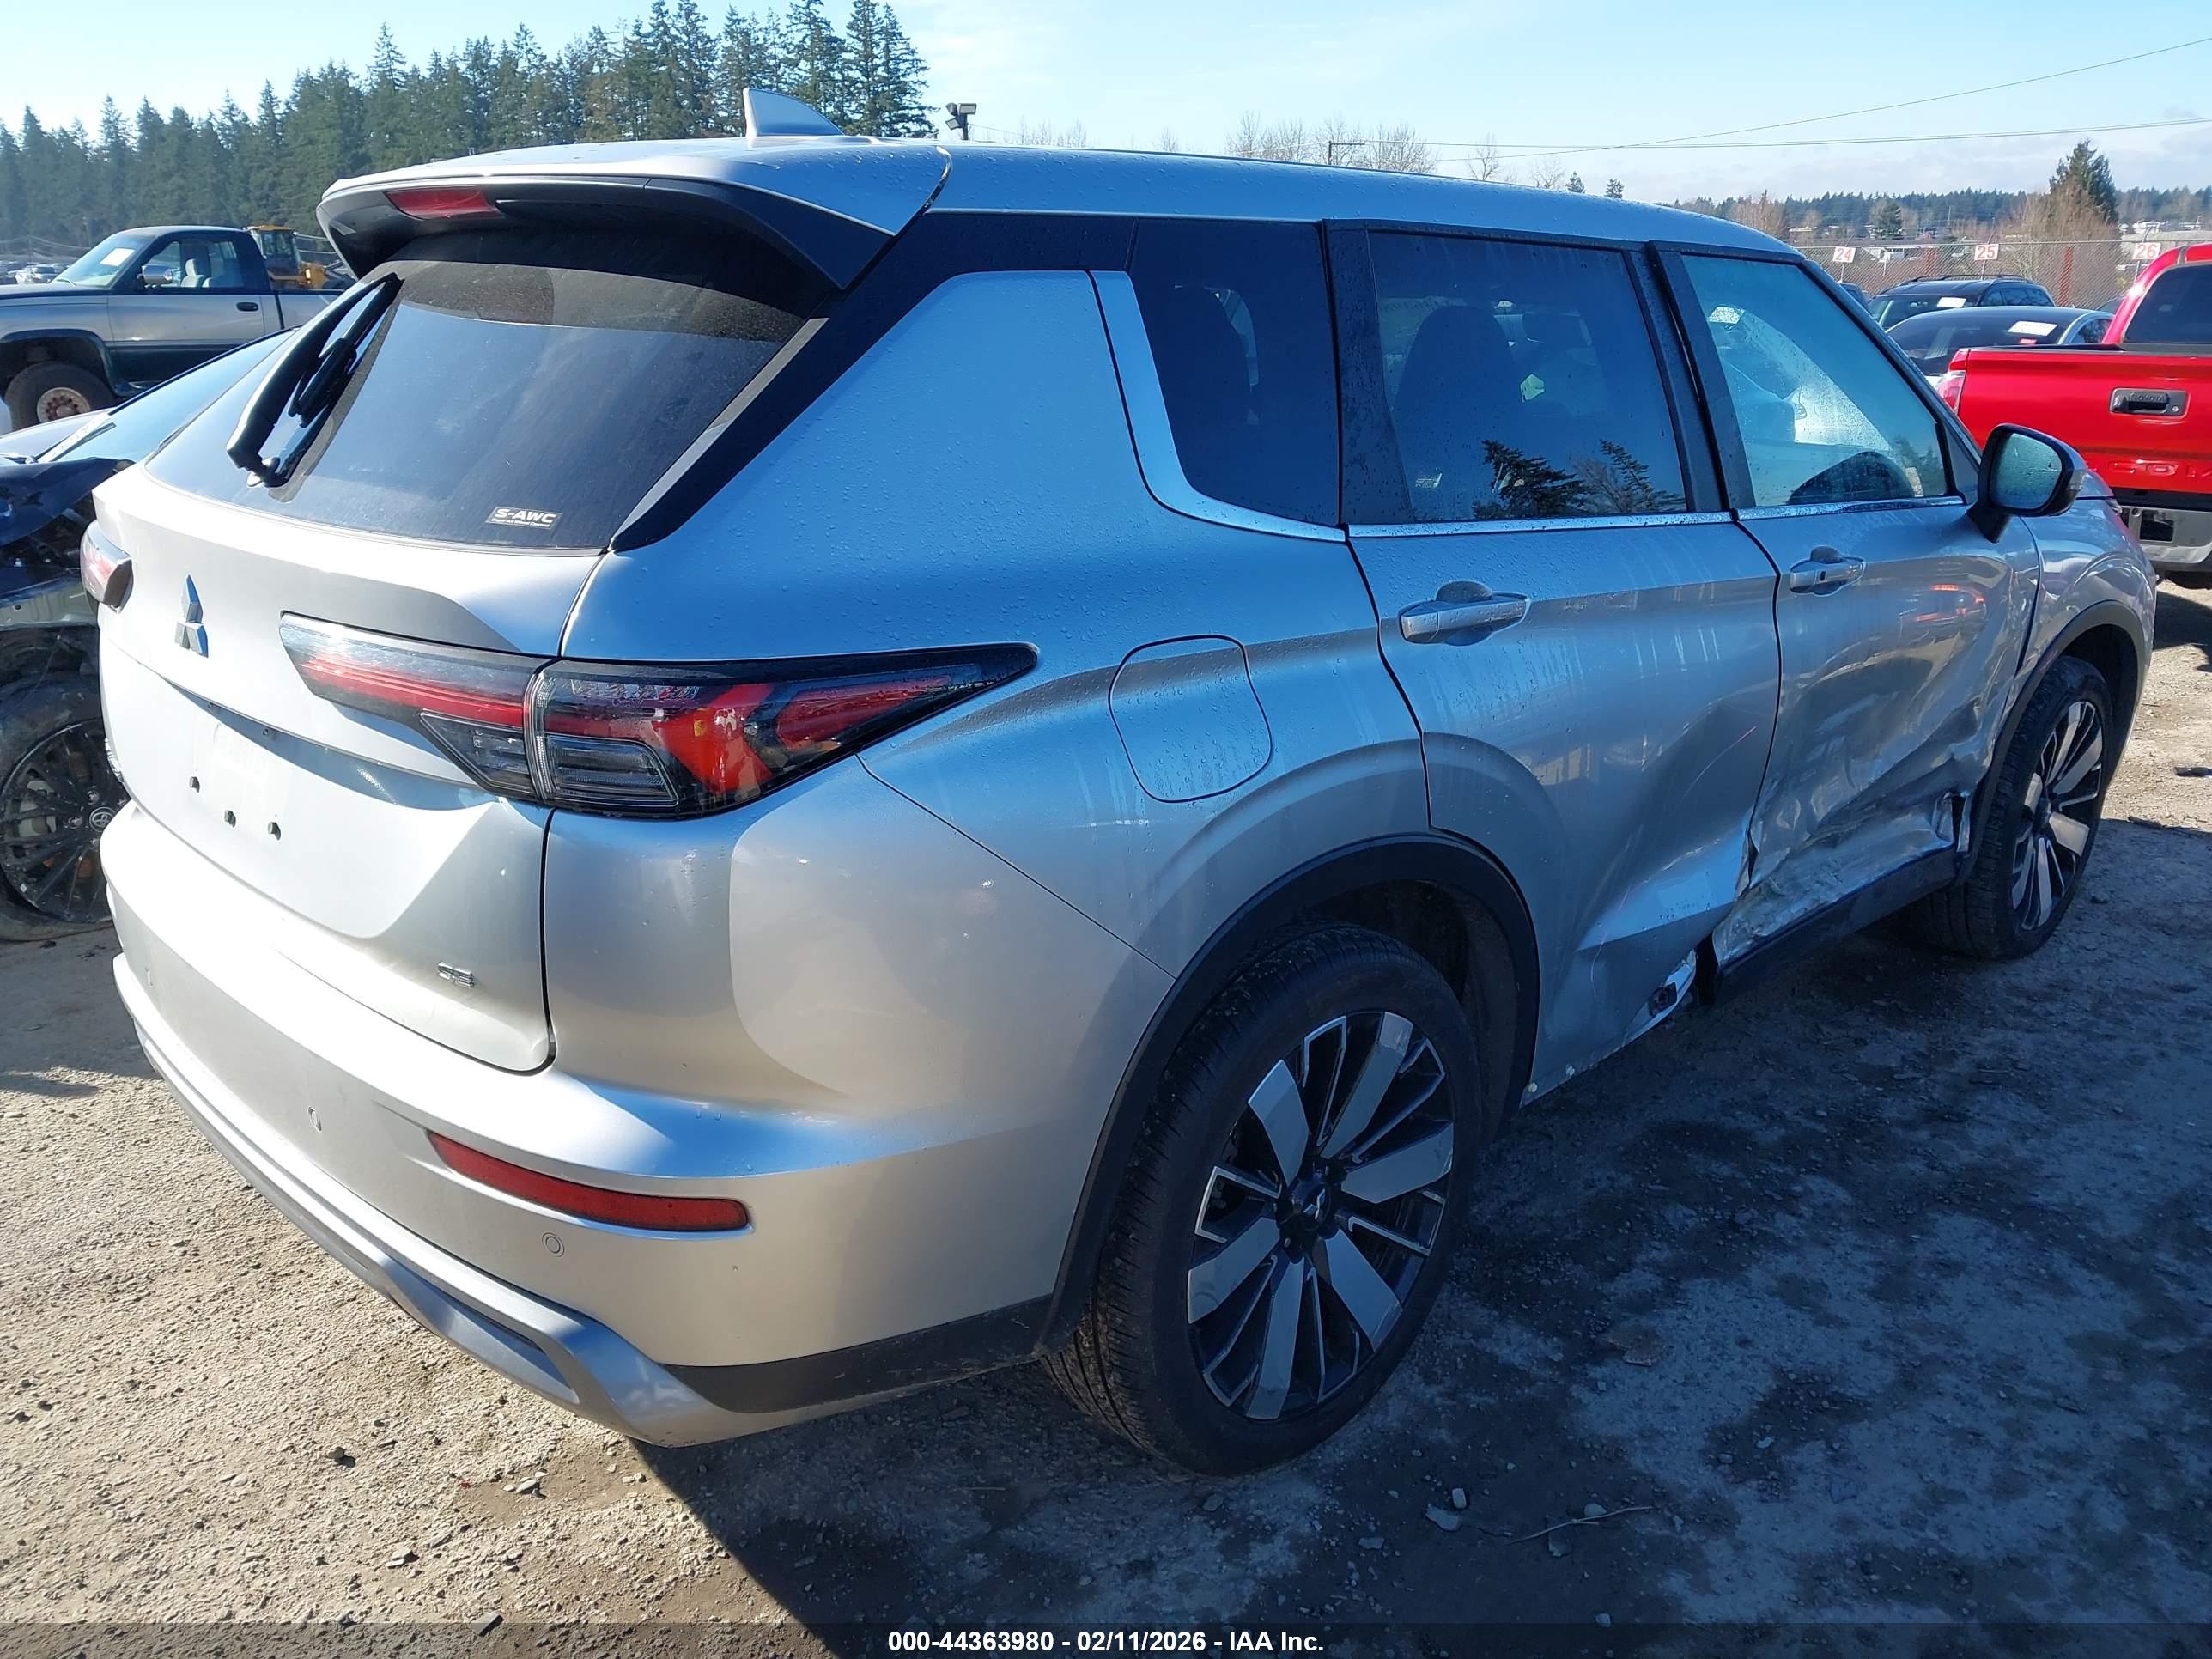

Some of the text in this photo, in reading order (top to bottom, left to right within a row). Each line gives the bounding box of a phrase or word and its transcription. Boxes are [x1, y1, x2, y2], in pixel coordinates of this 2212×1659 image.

[1835, 248, 1852, 261] 24
[1977, 245, 1996, 258] 25
[2136, 243, 2157, 258] 26
[495, 508, 556, 523] S-AWC
